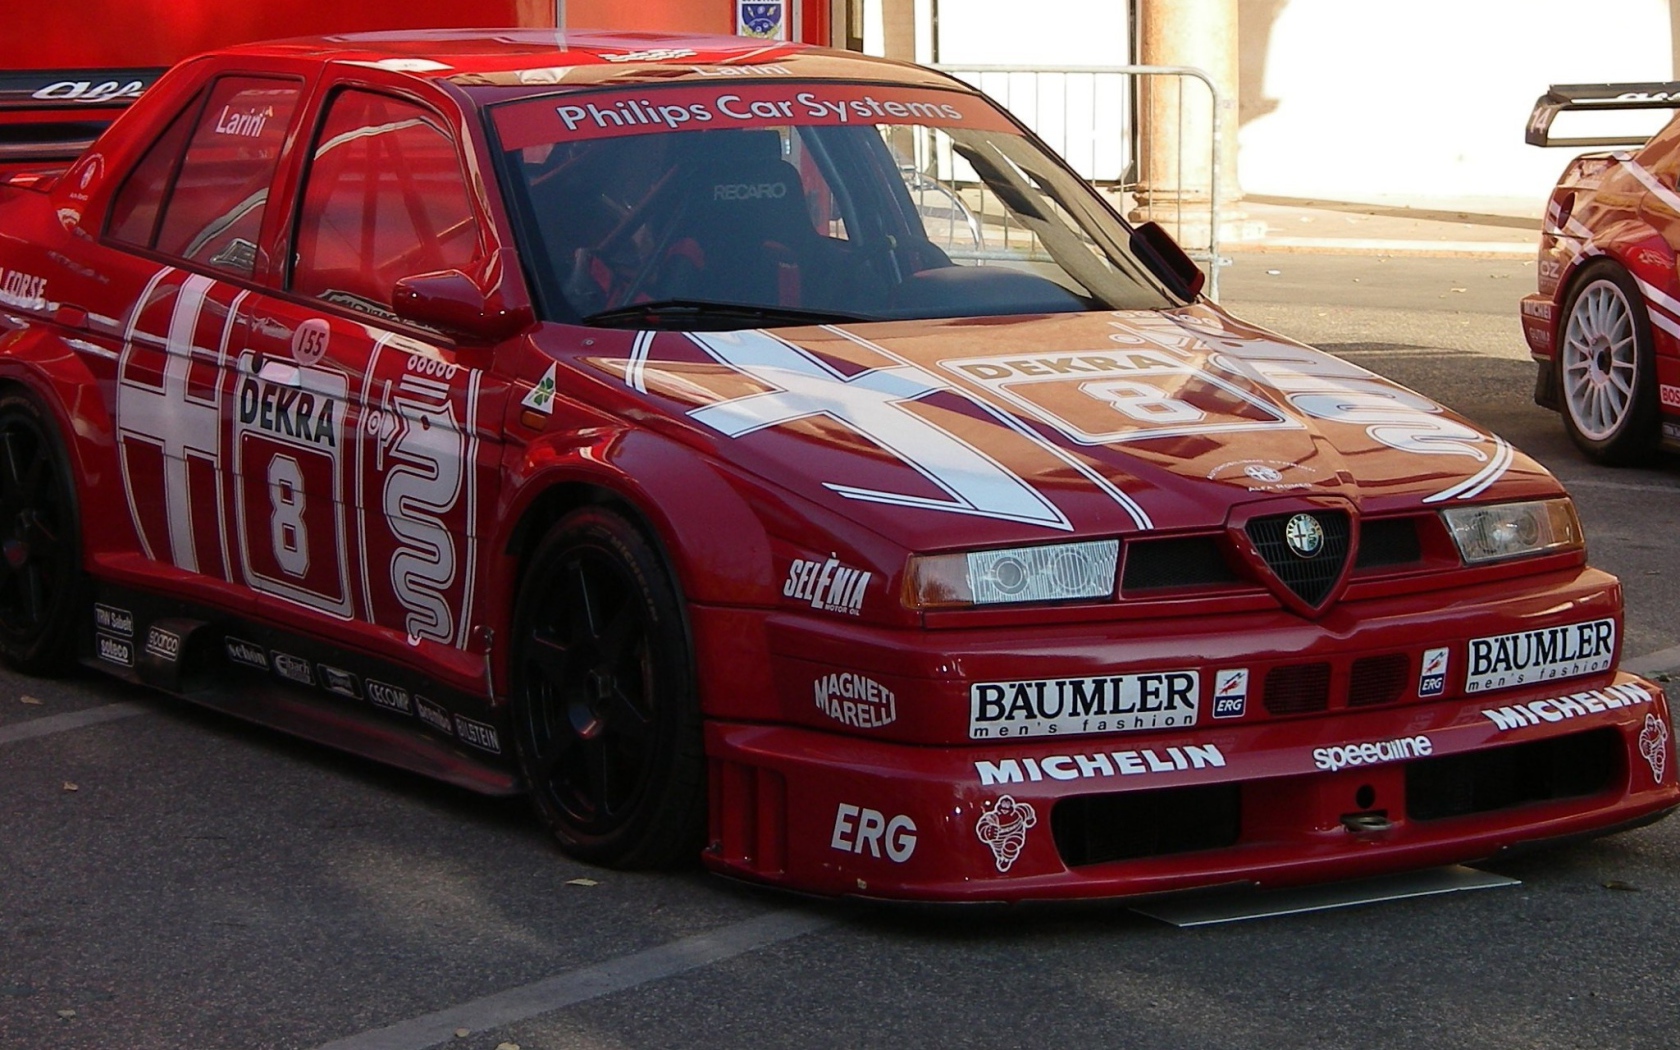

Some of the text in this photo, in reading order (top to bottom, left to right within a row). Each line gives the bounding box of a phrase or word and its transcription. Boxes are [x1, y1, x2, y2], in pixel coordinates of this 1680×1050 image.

[691, 65, 794, 77] Larini
[215, 104, 267, 138] Larini
[556, 92, 963, 131] Philips Car Systems
[1530, 106, 1552, 134] 14
[714, 183, 787, 201] RECARO
[4, 269, 48, 300] CORSE
[1541, 260, 1561, 279] OZ
[297, 328, 326, 356] 155
[958, 354, 1181, 381] DEKRA
[240, 378, 336, 447] DEKRA
[1077, 380, 1208, 424] 8
[267, 453, 311, 580] 8
[824, 603, 860, 617] MOTOR OIL
[1470, 620, 1613, 677] BÄUMLER
[814, 672, 896, 712] MAGNETI
[1422, 677, 1443, 691] ERG
[1468, 659, 1610, 692] men's fashion
[814, 688, 896, 728] MARELLI
[975, 673, 1195, 722] BÄUMLER
[1216, 698, 1242, 712] ERG
[1481, 682, 1653, 731] MICHELIN
[973, 714, 1194, 738] men's fashion
[974, 744, 1227, 786] MICHELIN
[831, 802, 917, 863] ERG
